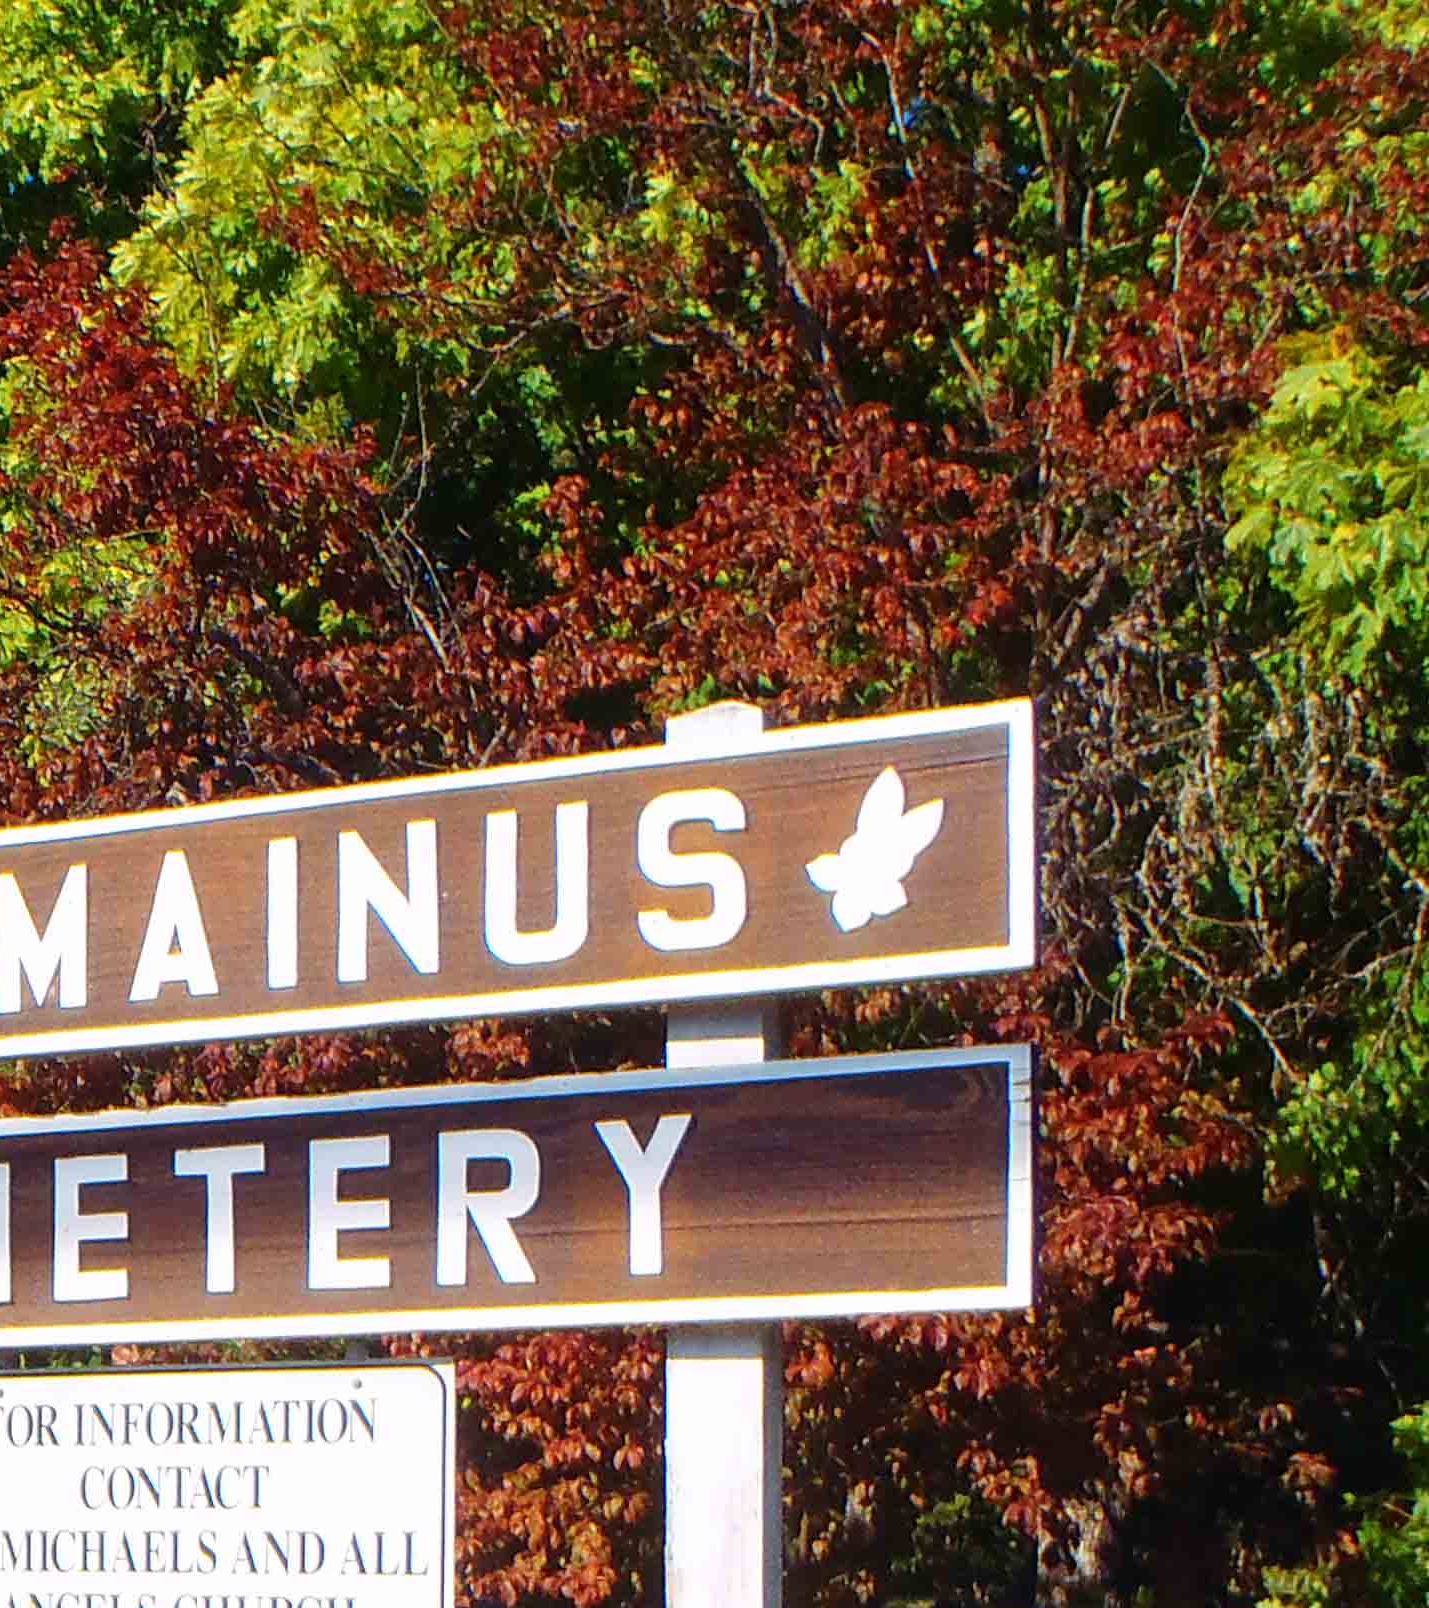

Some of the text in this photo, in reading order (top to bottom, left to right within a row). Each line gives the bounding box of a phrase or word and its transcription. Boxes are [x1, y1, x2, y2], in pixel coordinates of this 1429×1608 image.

[74, 1398, 378, 1447] INFORMATION
[80, 1465, 269, 1511] CONTACT
[0, 1528, 218, 1575] MICHAELS
[232, 1530, 325, 1576] AND
[340, 1530, 429, 1576] ALL
